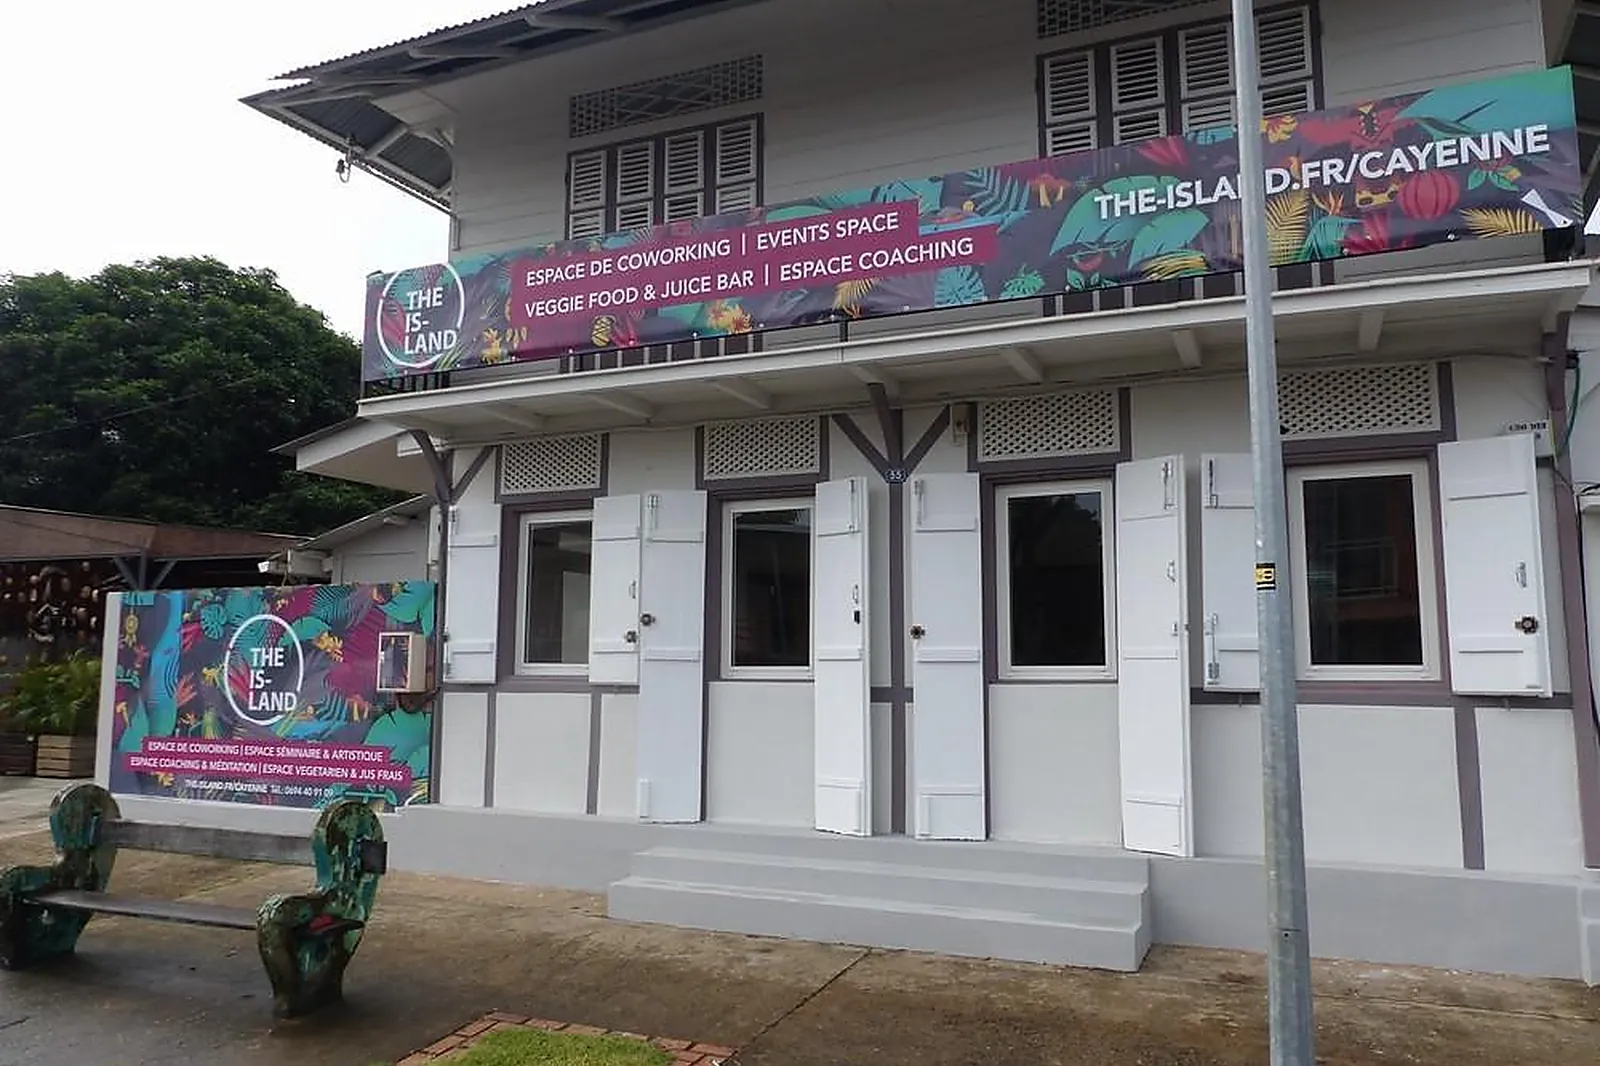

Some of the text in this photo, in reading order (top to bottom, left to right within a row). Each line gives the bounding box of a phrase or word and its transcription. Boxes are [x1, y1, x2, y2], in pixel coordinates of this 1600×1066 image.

[1094, 124, 1549, 221] THE-ISLAD.FR/CAYENNE
[526, 263, 585, 287] ESPACE
[590, 258, 612, 276] DE
[617, 239, 731, 272] COWORKING
[757, 223, 830, 250] EVENTS
[836, 212, 899, 236] SPACE
[525, 295, 584, 318] VEGGIE
[588, 286, 639, 309] FOOD
[643, 284, 656, 300] &
[661, 275, 711, 298] JUICE
[717, 270, 754, 291] BAR
[780, 254, 853, 282] ESPACE
[858, 237, 974, 270] COACHING
[406, 286, 443, 310] THE
[405, 312, 429, 333] IS-
[404, 329, 457, 354] LAND
[250, 647, 284, 667] THE
[249, 669, 272, 689] IS-
[248, 691, 297, 711] LAND
[148, 741, 176, 752] ESPACE
[176, 742, 188, 753] DE
[189, 743, 239, 755] COWORKING
[244, 745, 274, 756] ESPACE
[322, 749, 330, 759] &
[331, 749, 384, 762] ARTISTIQUE
[130, 756, 159, 768] ESPACE
[159, 758, 201, 770] COACHING
[201, 760, 208, 770] &
[262, 763, 294, 775] ESPACE
[350, 768, 357, 779] &
[359, 769, 376, 780] JUS
[377, 770, 403, 781] FRAIS
